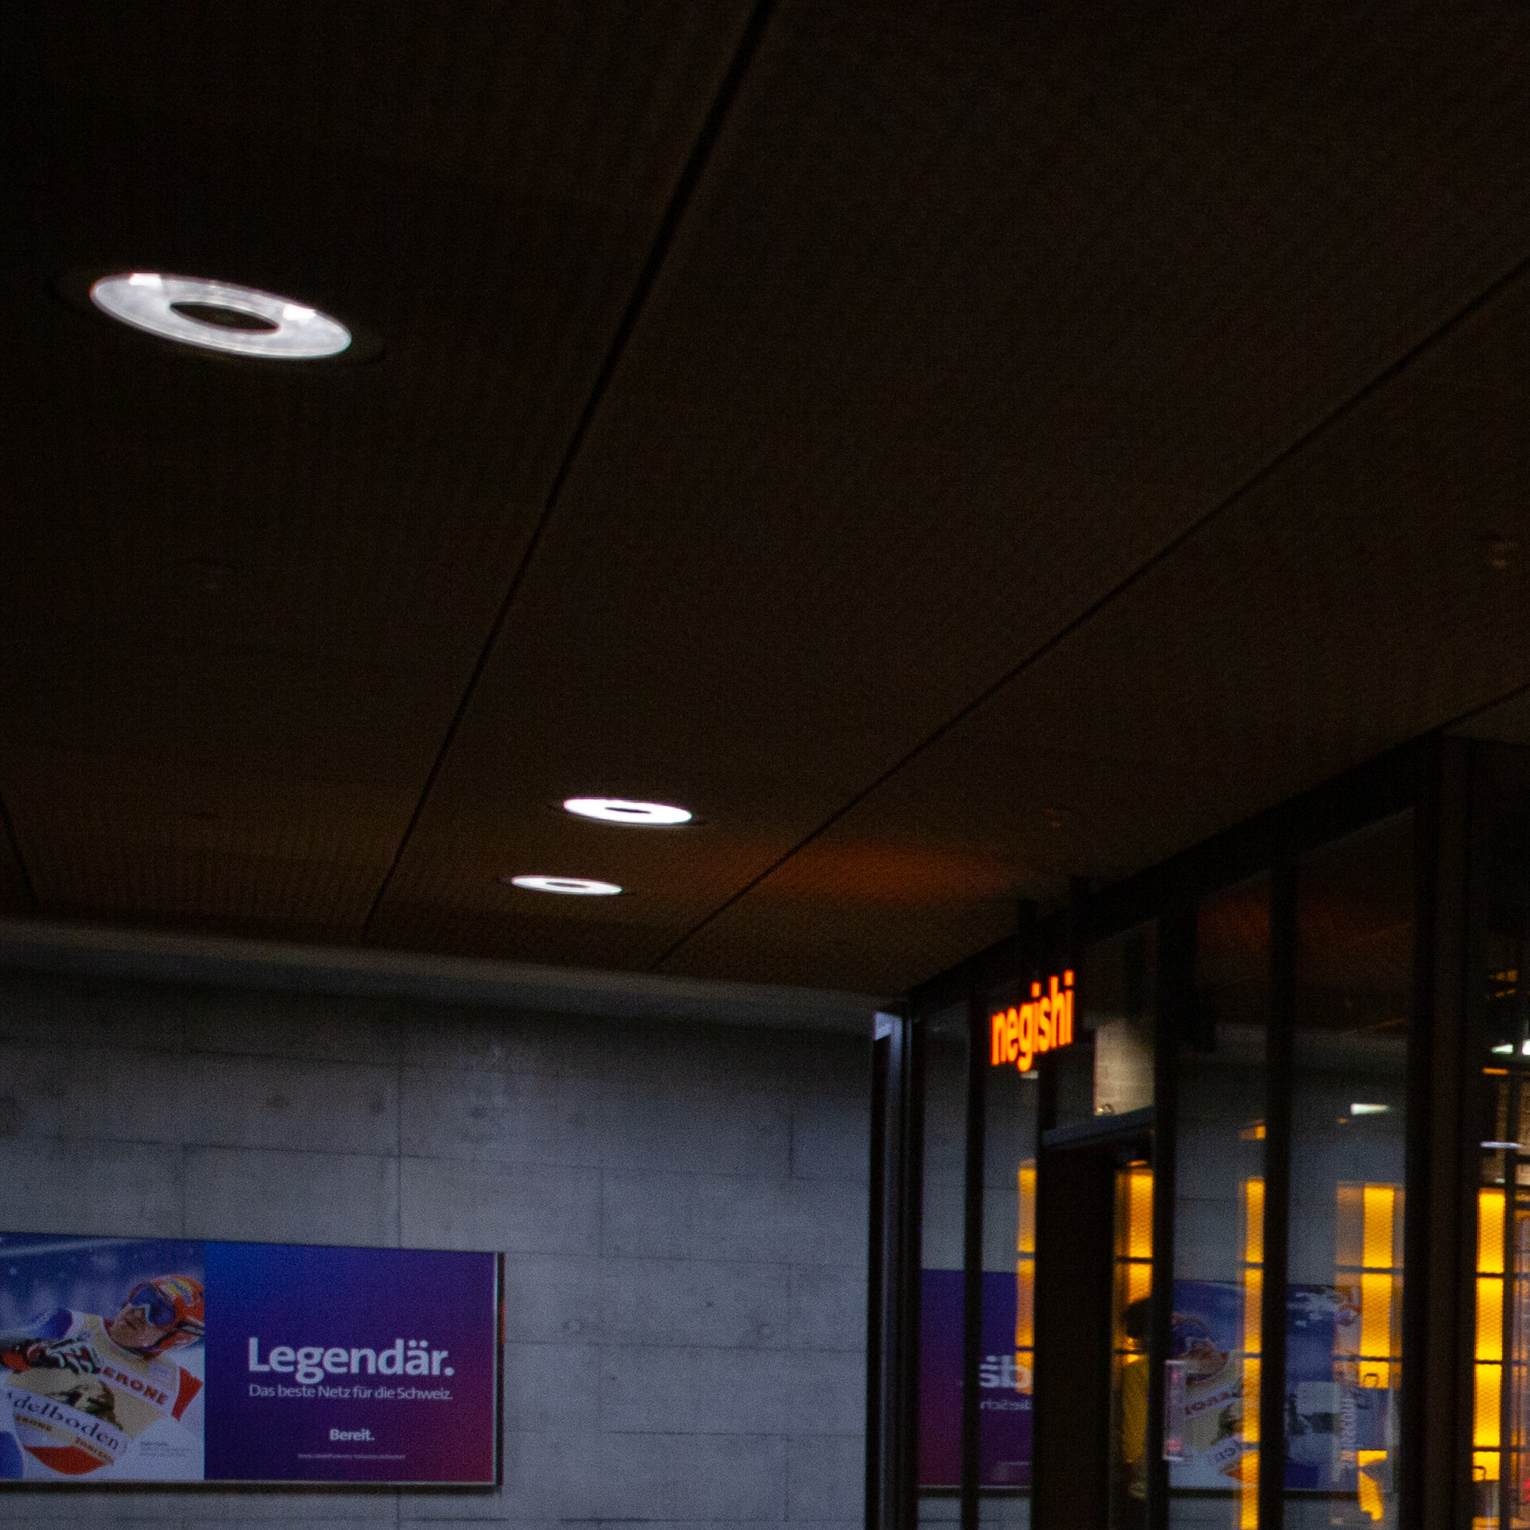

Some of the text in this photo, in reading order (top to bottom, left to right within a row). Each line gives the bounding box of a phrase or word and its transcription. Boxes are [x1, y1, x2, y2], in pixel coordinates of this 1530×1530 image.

[990, 969, 1074, 1072] negishi
[248, 1337, 455, 1384] Legendär.
[102, 1366, 169, 1406] ERONE
[249, 1384, 454, 1401] Das beste Netz für die Schweiz.
[329, 1428, 375, 1442] Bereit.
